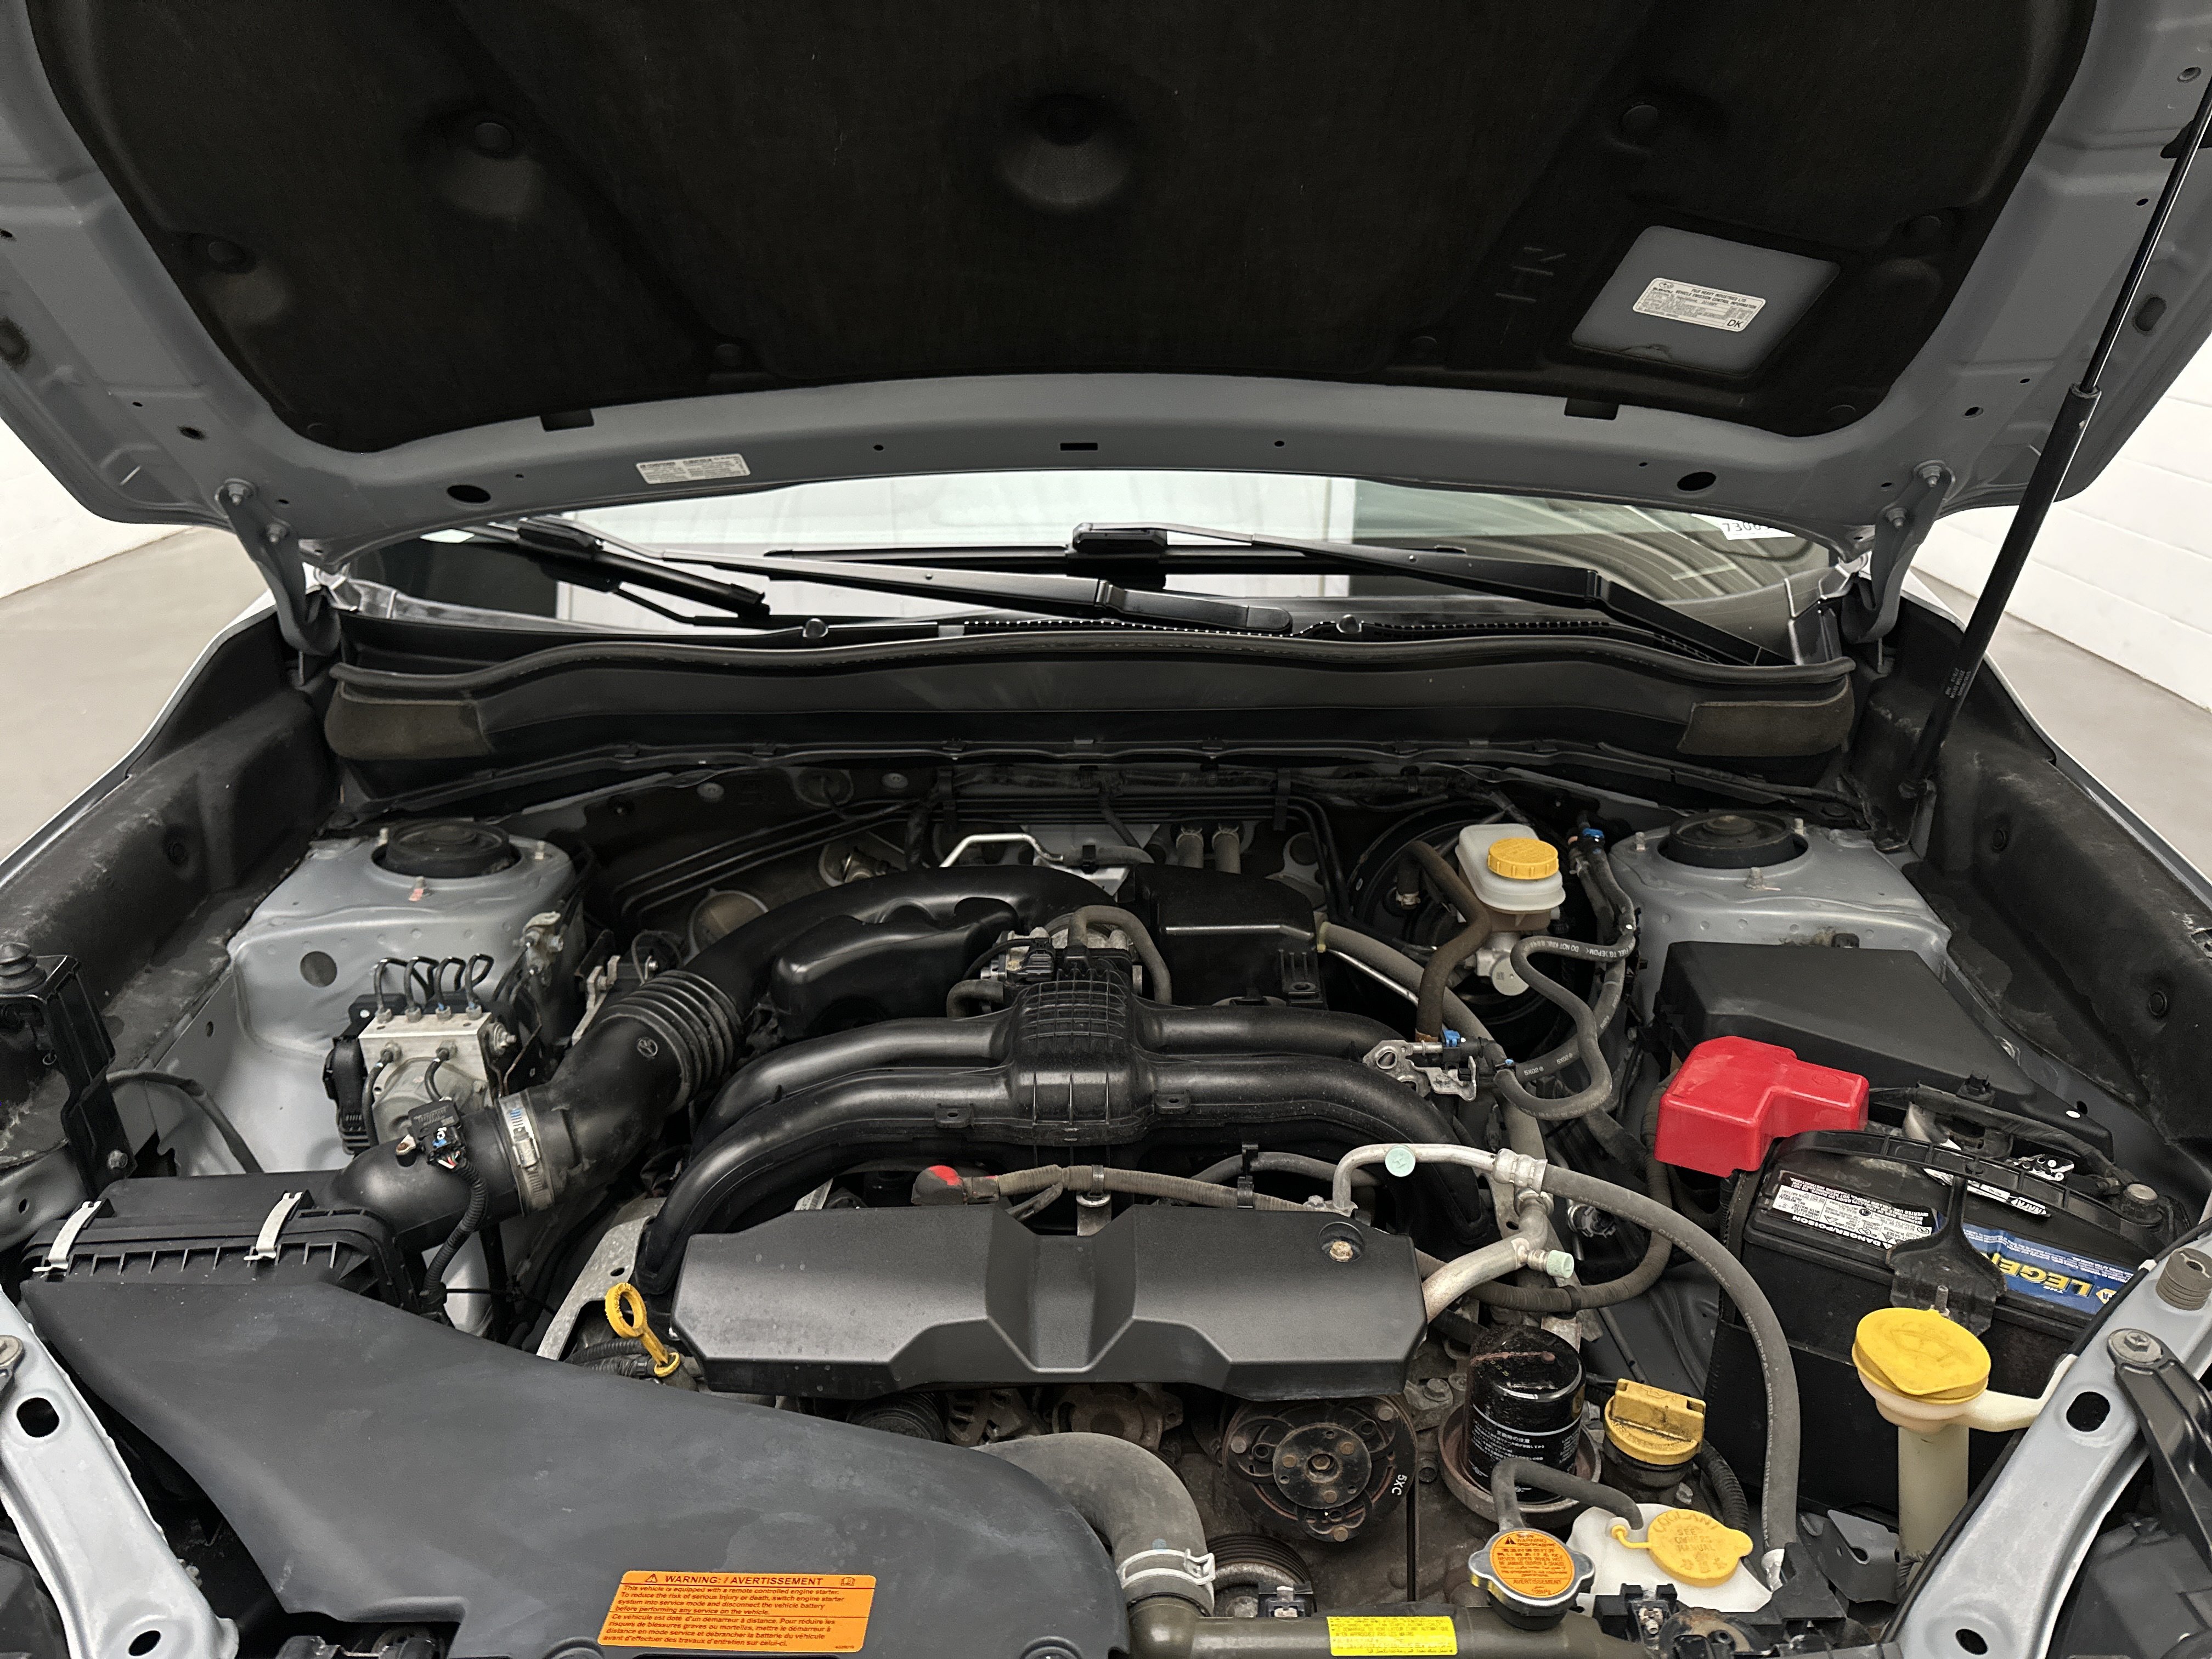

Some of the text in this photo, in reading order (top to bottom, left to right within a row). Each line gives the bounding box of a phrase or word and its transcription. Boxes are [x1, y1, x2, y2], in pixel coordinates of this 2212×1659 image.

[1727, 319, 1745, 328] DK
[1391, 1474, 1407, 1496] 5XC
[1653, 1511, 1719, 1532] COOLANT
[730, 1577, 823, 1585] AVERTISSEMENT
